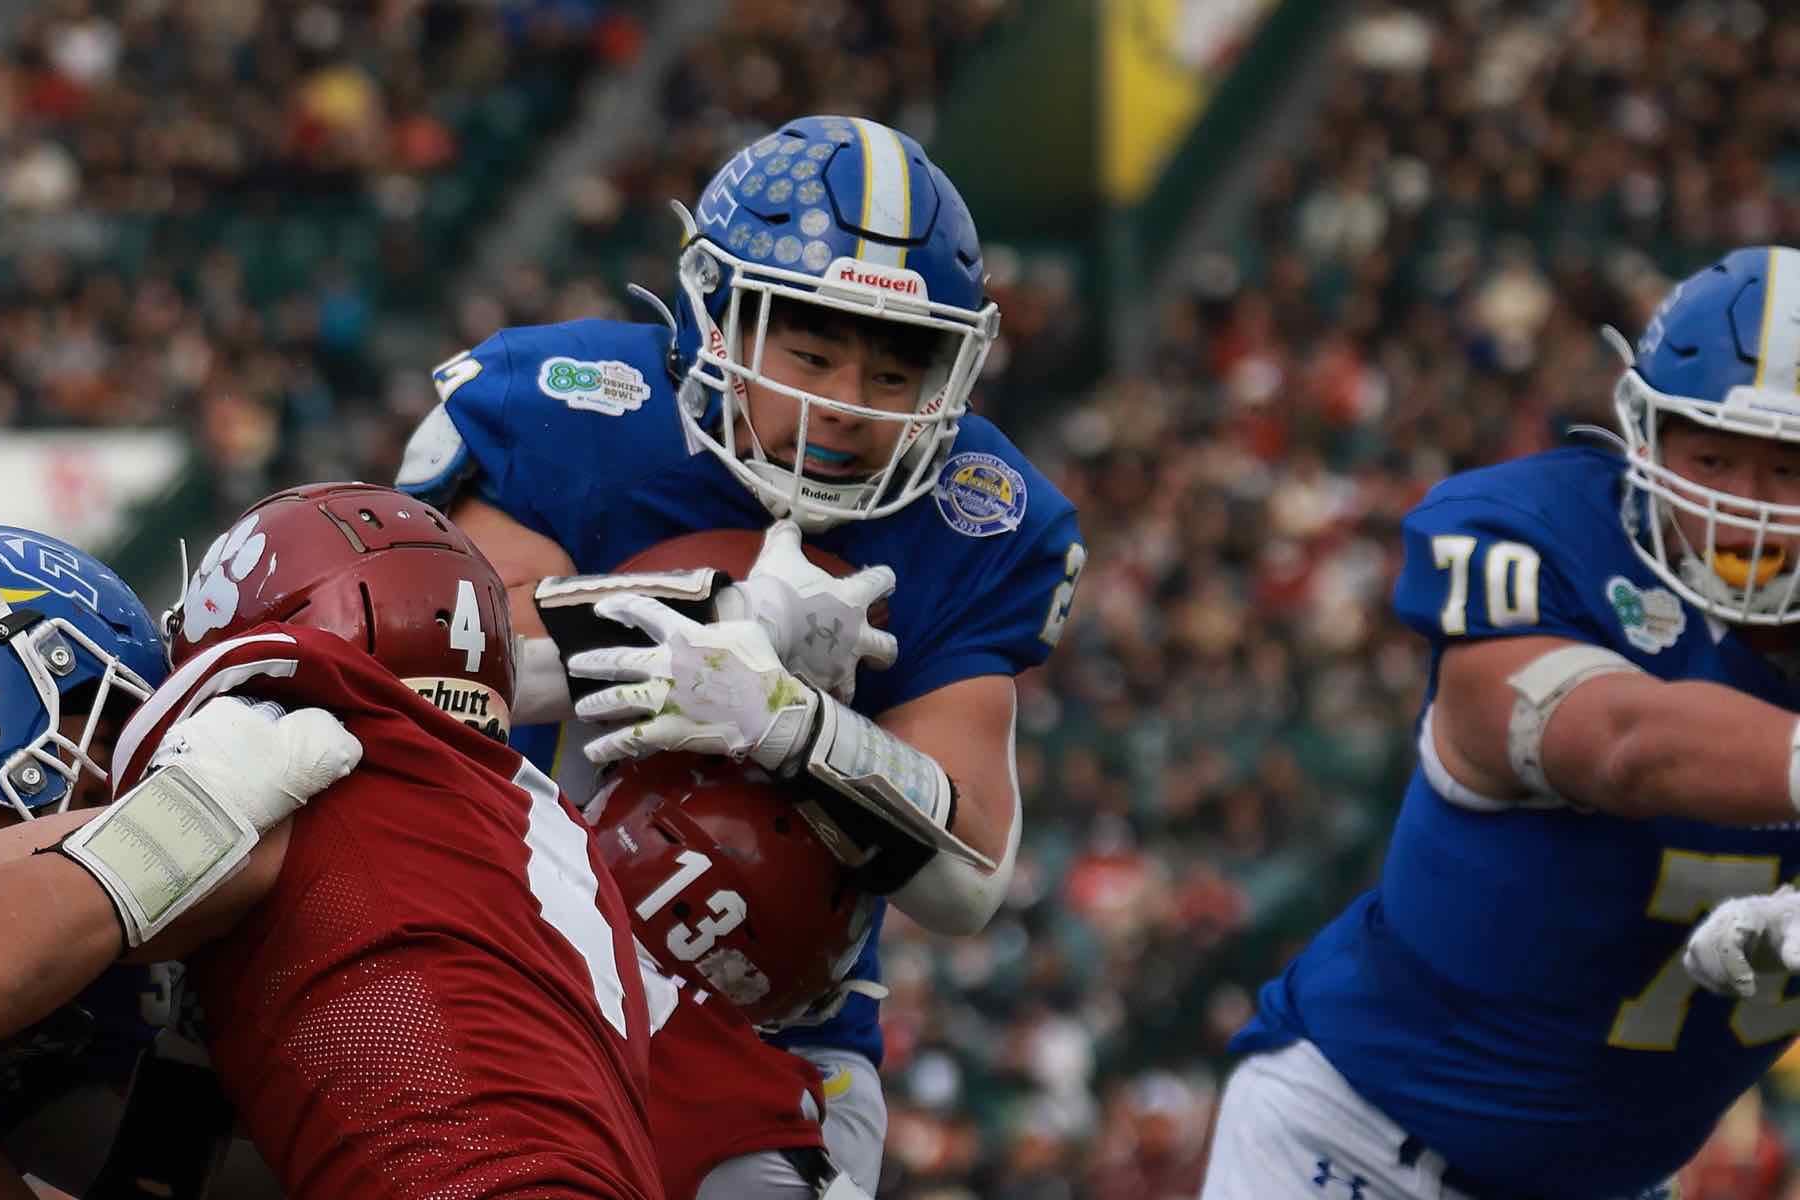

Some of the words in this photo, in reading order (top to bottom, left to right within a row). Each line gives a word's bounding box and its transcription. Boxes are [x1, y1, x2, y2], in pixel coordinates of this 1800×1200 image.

[839, 269, 918, 296] Riddell
[801, 487, 841, 503] Riddell
[450, 579, 486, 673] 4
[1431, 534, 1541, 634] 70
[635, 850, 748, 962] 13
